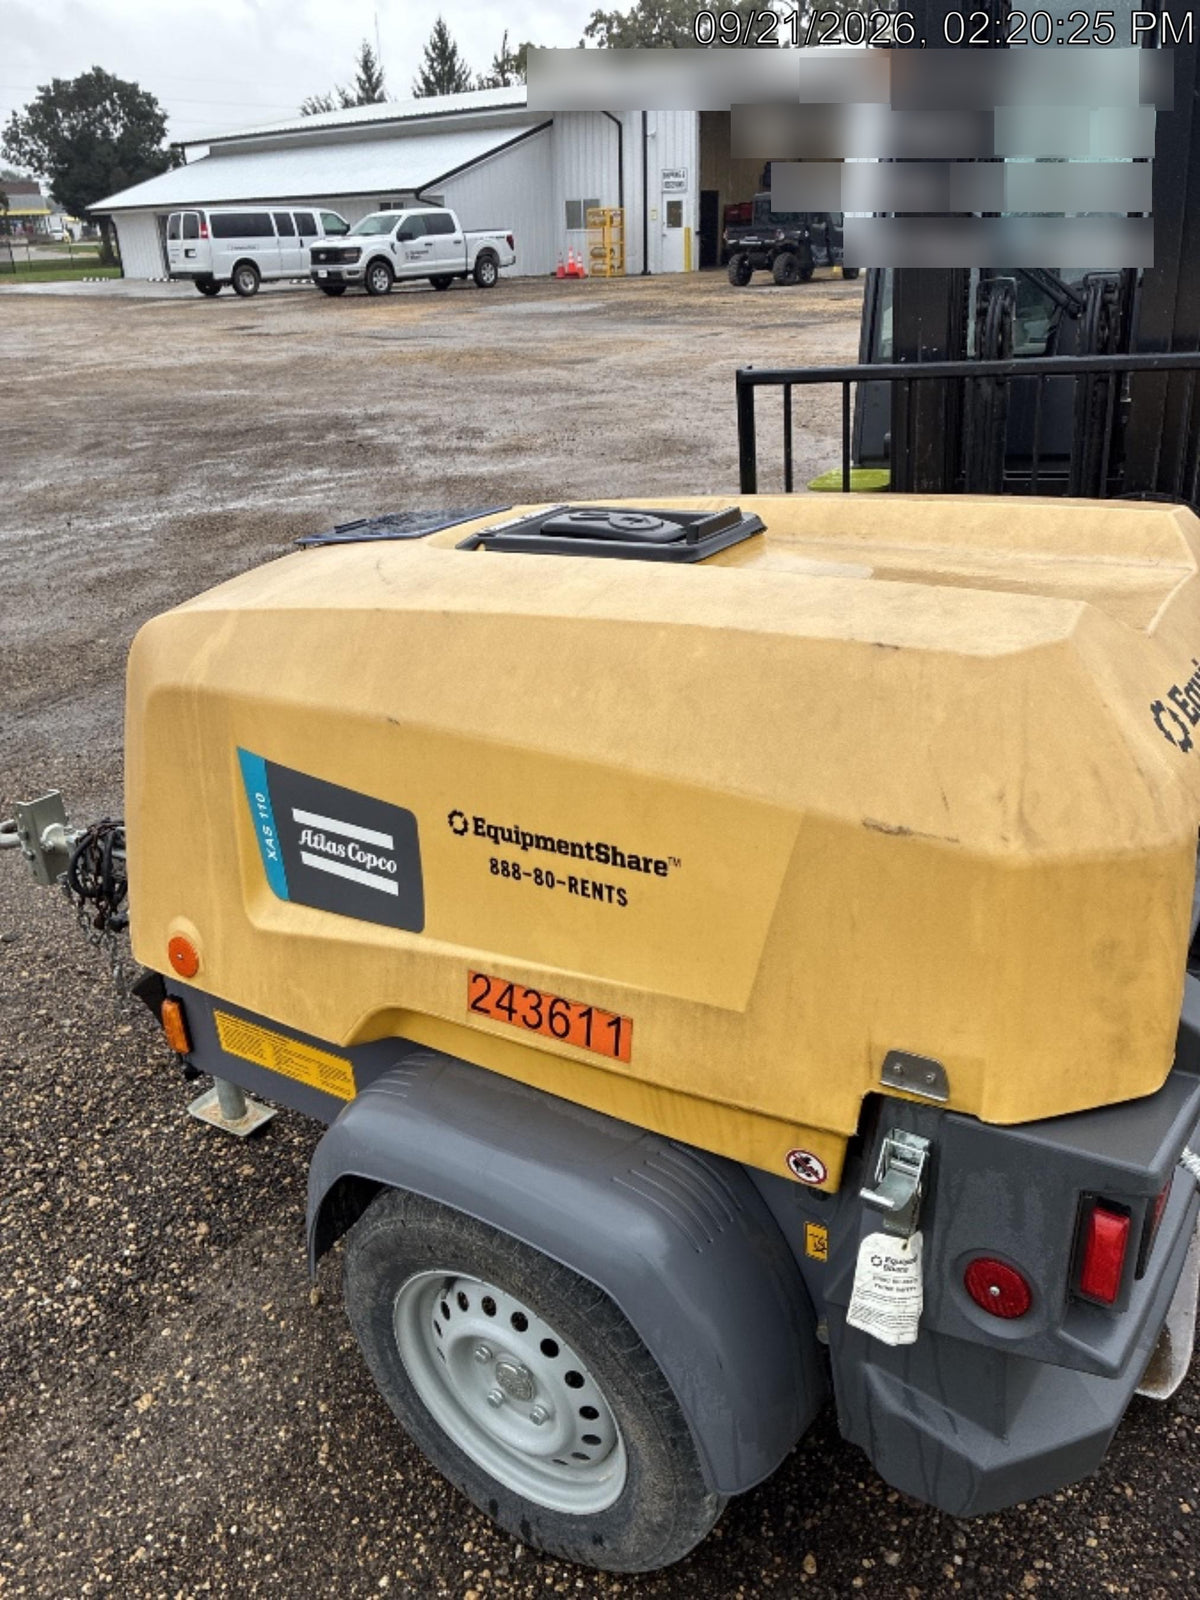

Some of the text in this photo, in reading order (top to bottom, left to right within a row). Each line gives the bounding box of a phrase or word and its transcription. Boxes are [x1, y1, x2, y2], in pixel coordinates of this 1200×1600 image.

[255, 792, 278, 862] XAS 110
[488, 856, 629, 908] 888-80-RENTS
[470, 973, 622, 1057] 243611
